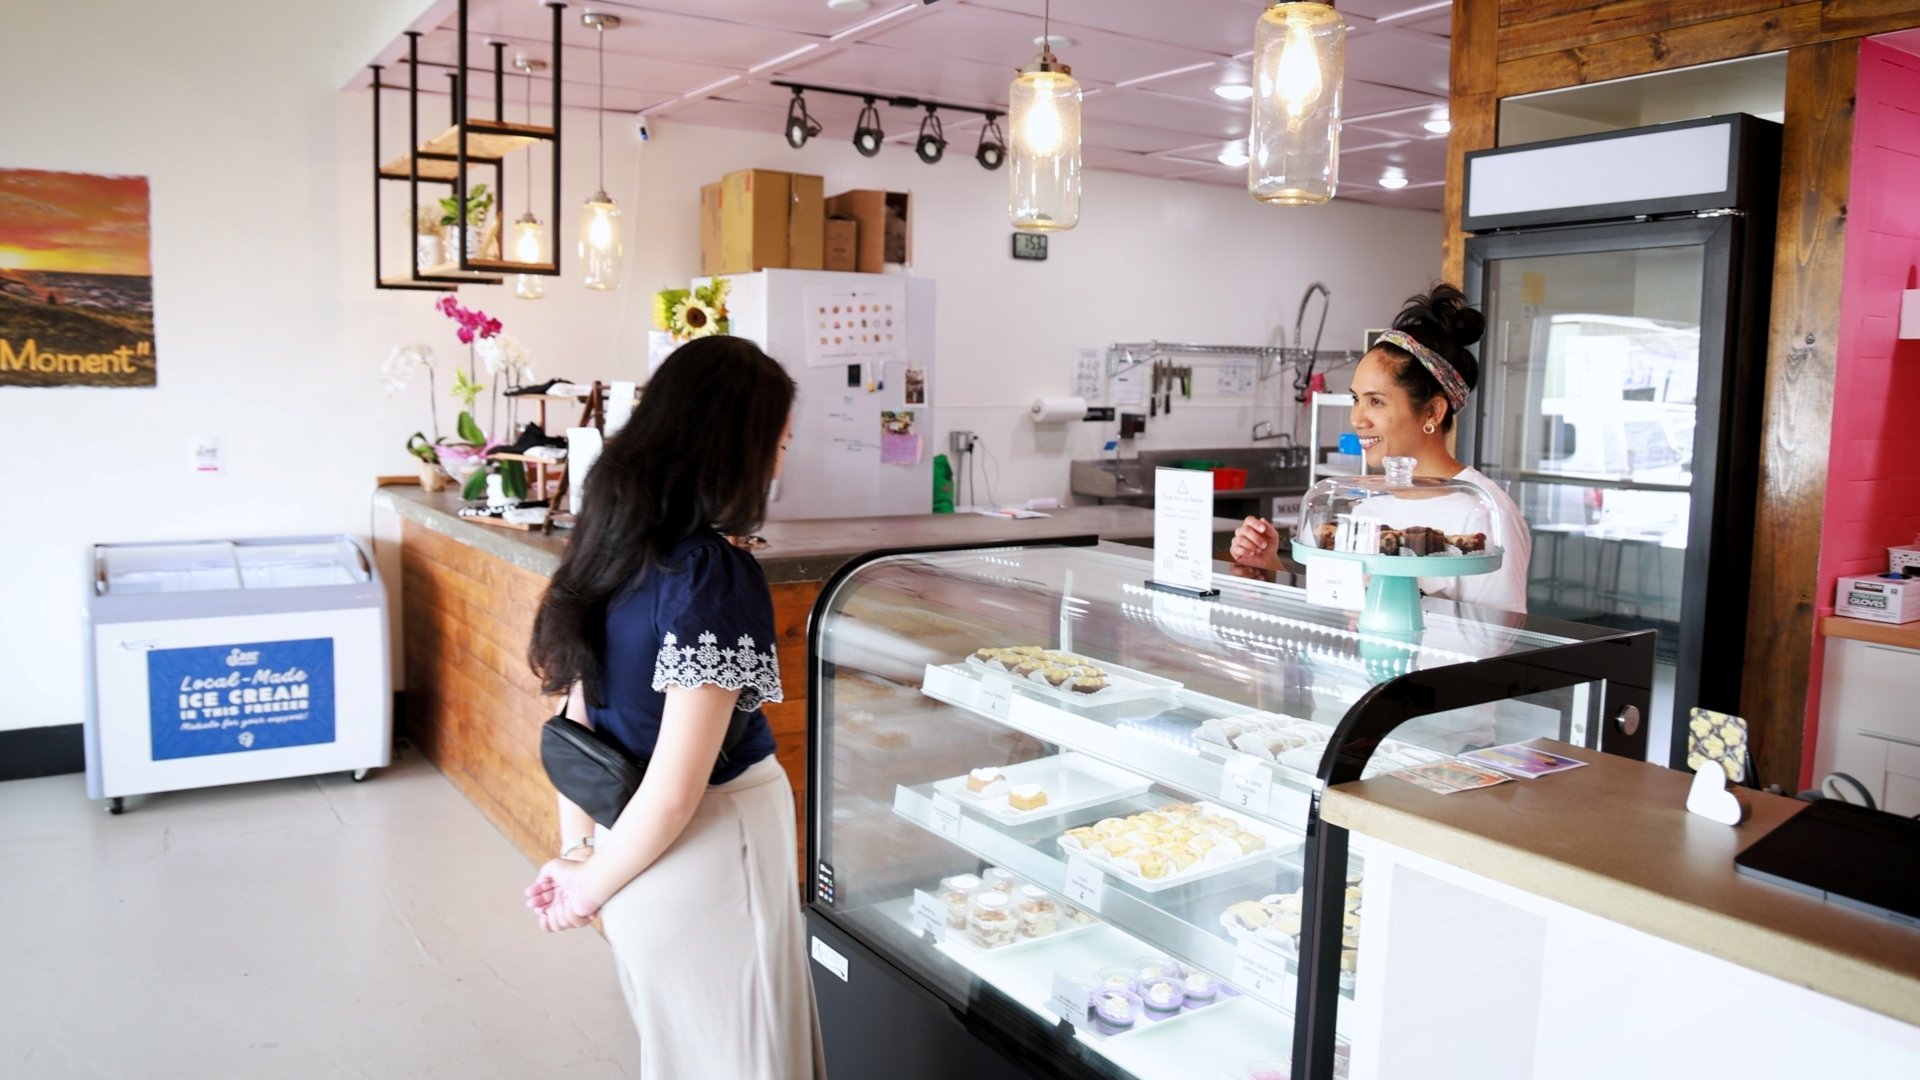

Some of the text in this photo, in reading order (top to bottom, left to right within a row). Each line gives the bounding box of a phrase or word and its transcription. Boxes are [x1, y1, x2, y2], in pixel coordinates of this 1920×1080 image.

[0, 338, 150, 373] Moment"
[1850, 597, 1885, 608] GLOVES
[179, 684, 309, 710] ICE CREAM
[180, 700, 309, 720] IN THIS FREEZER
[1241, 794, 1248, 805] 3
